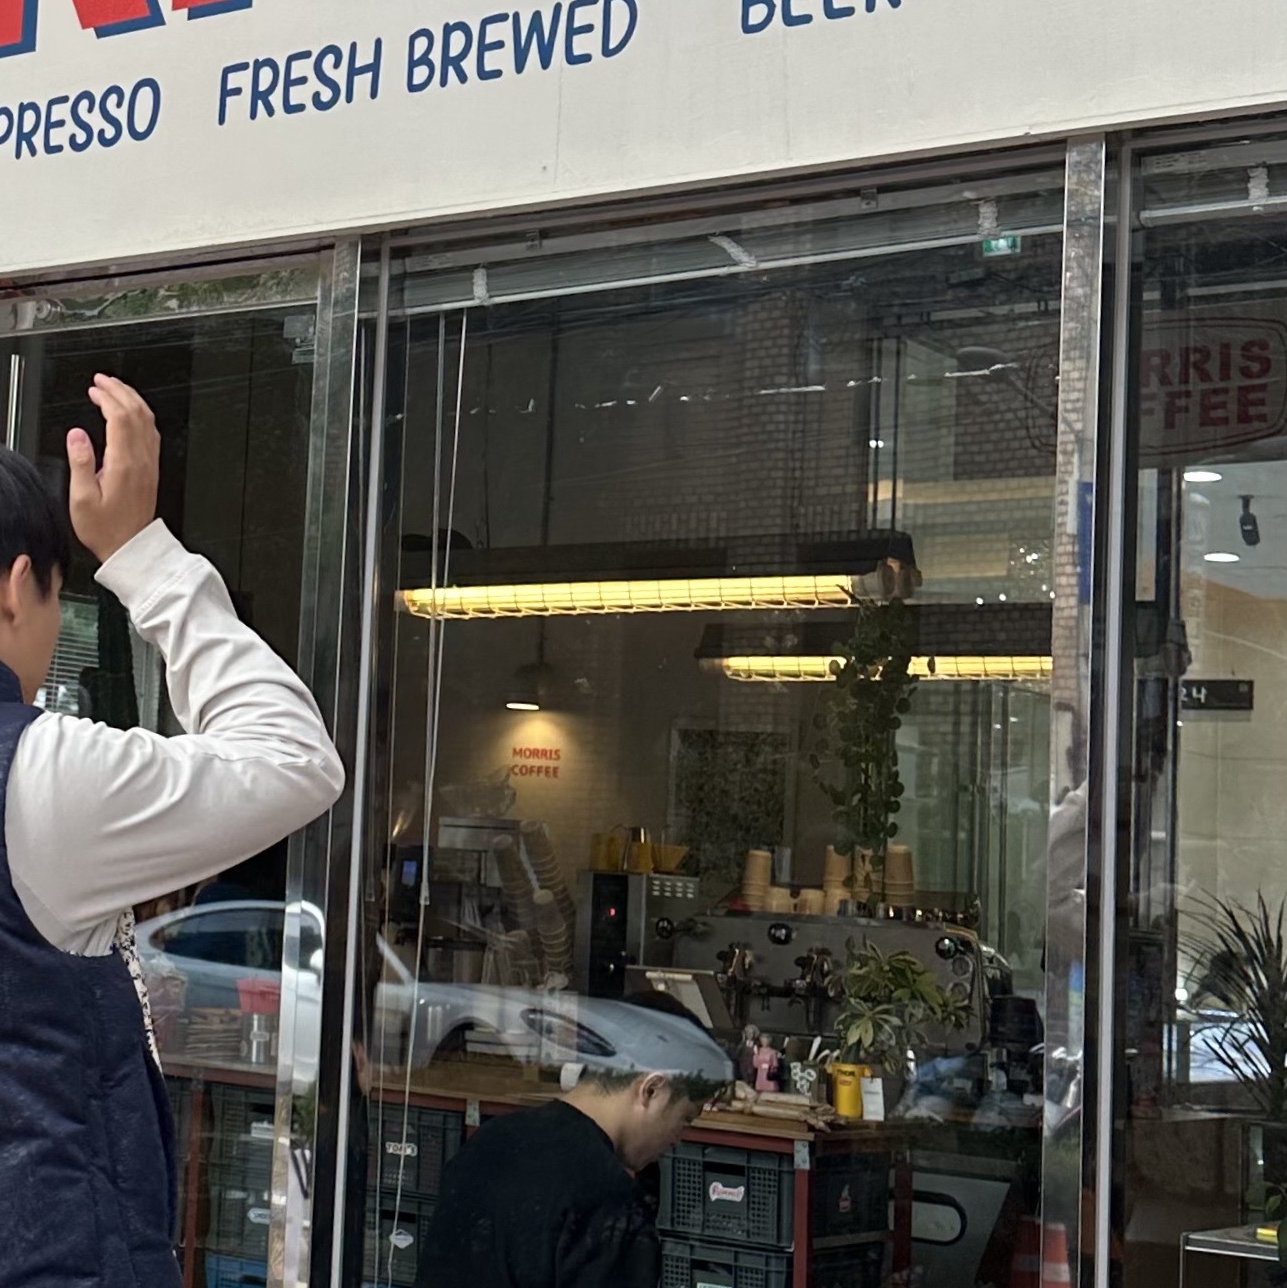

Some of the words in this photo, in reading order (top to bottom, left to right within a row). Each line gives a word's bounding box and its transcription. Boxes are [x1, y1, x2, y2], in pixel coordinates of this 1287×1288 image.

[217, 37, 383, 126] FRESH
[406, 0, 638, 94] BREWED
[512, 747, 561, 761] MORRIS
[511, 764, 560, 779] COFFEE
